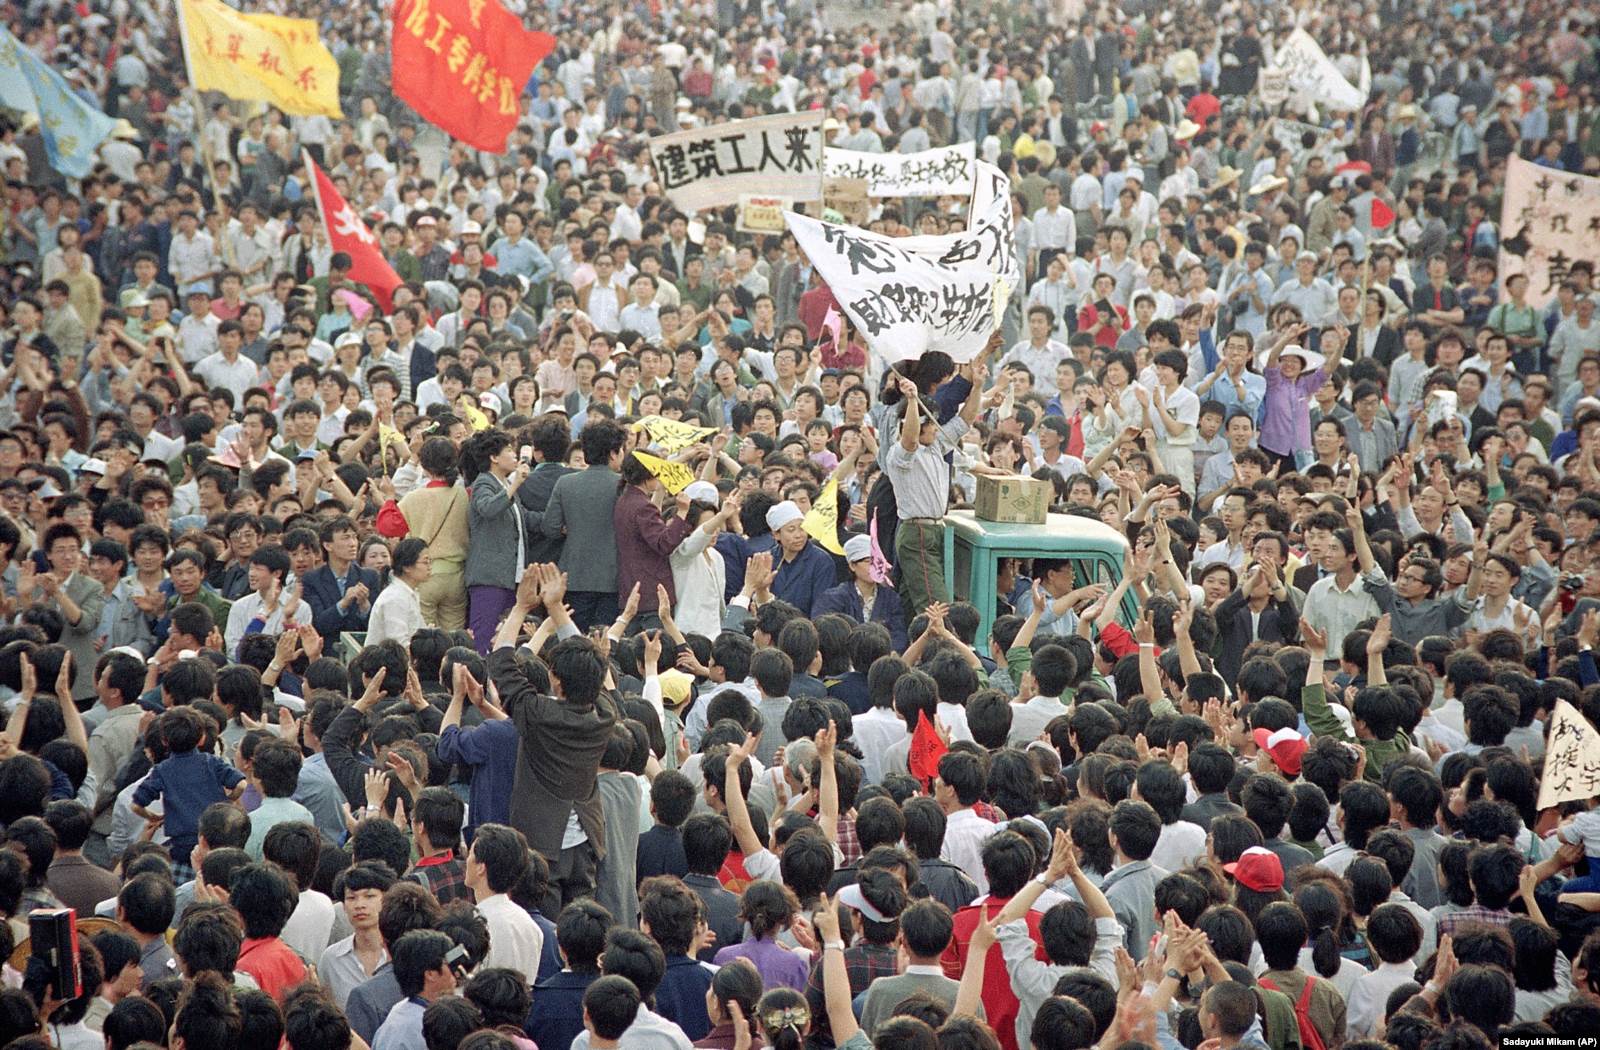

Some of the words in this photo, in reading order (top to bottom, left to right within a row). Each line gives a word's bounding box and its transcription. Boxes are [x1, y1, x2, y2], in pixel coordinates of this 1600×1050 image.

[656, 125, 821, 190] 建筑工人来
